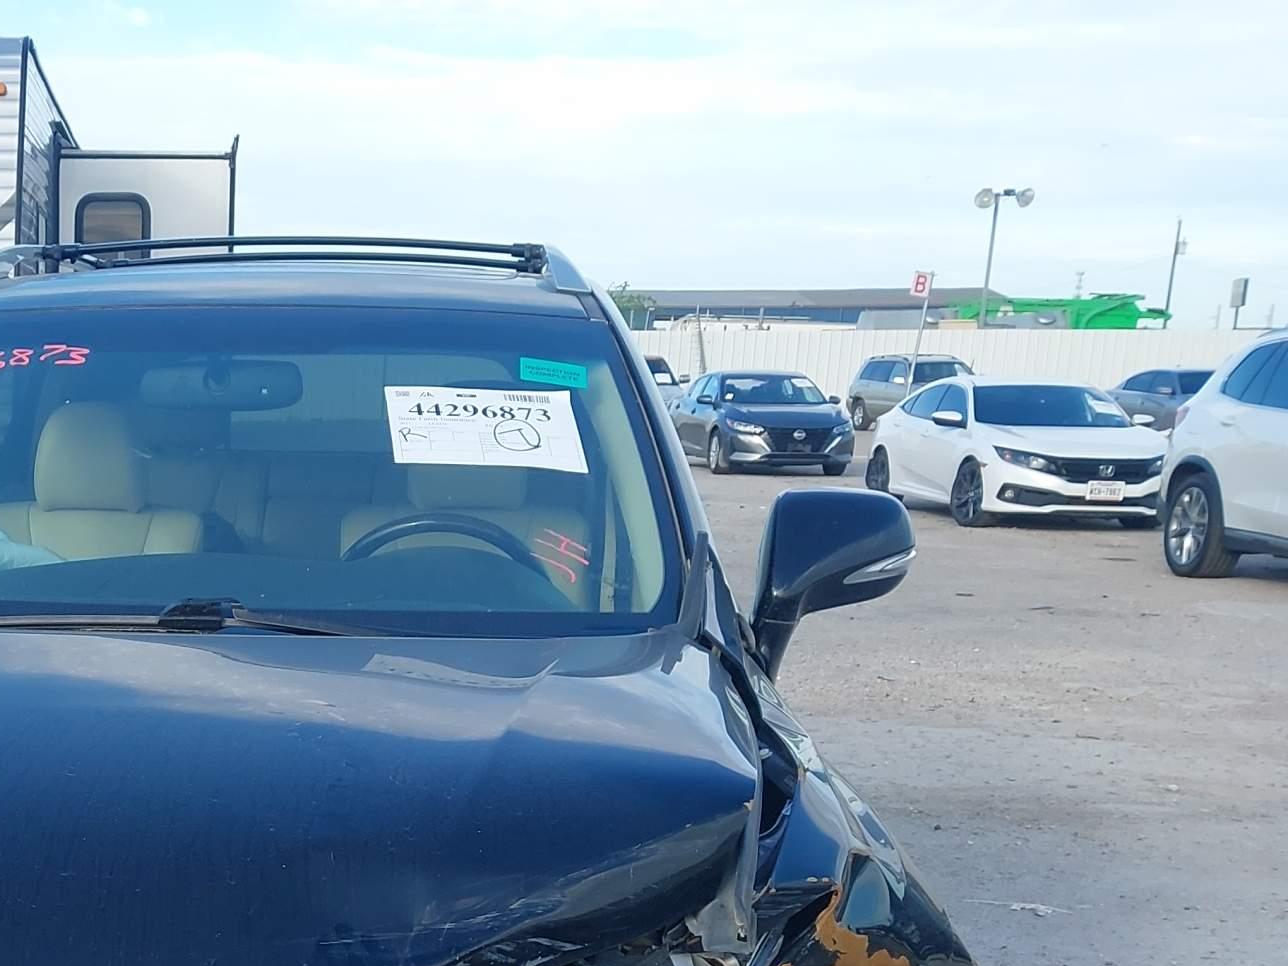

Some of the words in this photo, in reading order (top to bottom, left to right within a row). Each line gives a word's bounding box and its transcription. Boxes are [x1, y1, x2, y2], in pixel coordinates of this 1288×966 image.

[914, 274, 928, 293] B
[408, 402, 552, 422] 44296873
[398, 426, 428, 442] R
